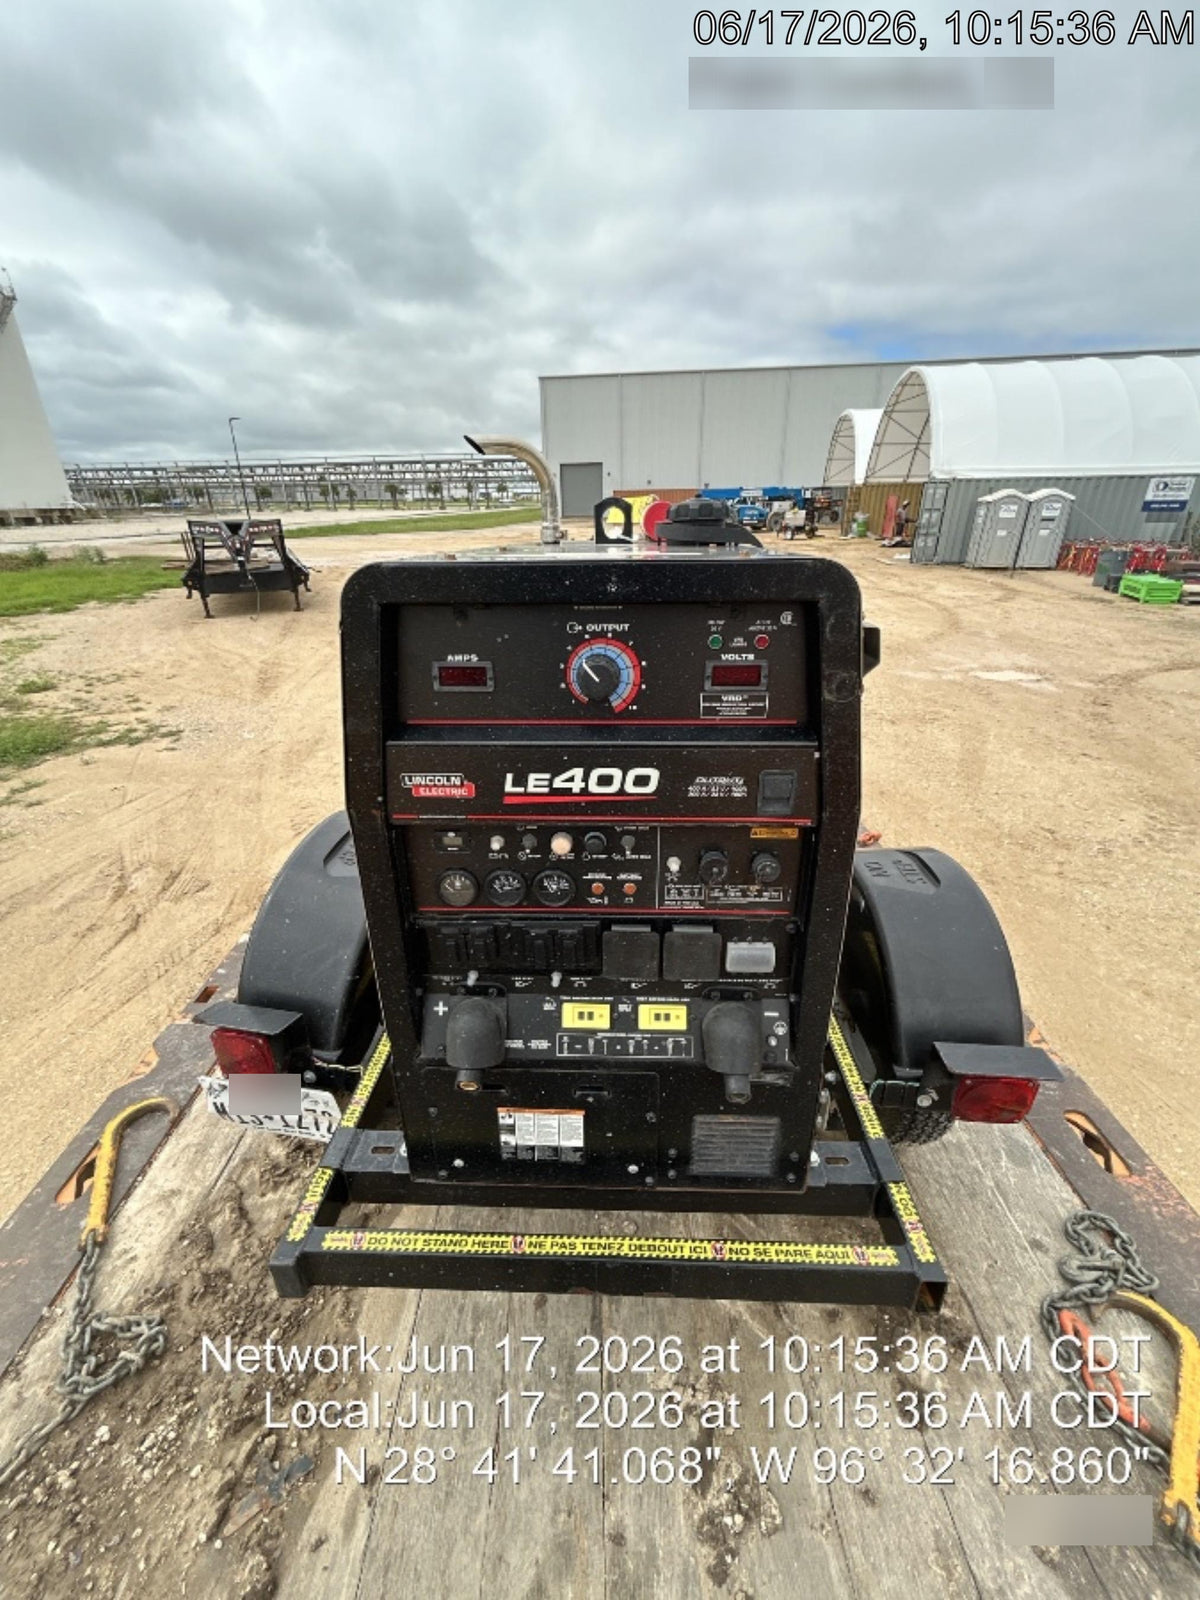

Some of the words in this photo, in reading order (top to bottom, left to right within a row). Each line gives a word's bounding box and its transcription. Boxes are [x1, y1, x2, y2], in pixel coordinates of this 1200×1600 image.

[585, 623, 631, 633] OUTPUT
[447, 653, 479, 662] AMPS
[720, 653, 755, 661] VOLTS
[404, 775, 462, 787] LINCOLN
[504, 768, 660, 794] LE400
[418, 786, 469, 797] ELECTRIC
[367, 1238, 389, 1247] DO
[393, 1238, 419, 1248] NOT
[422, 1239, 468, 1248] STAND
[471, 1239, 509, 1250] HERE
[527, 1240, 547, 1250] NE
[550, 1241, 577, 1251] PAS
[581, 1242, 624, 1252] TENEZ
[628, 1243, 685, 1254] DEBOUT
[689, 1244, 708, 1255] ICI
[728, 1247, 750, 1256] NO
[753, 1248, 772, 1258] SE
[775, 1248, 813, 1259] PARE
